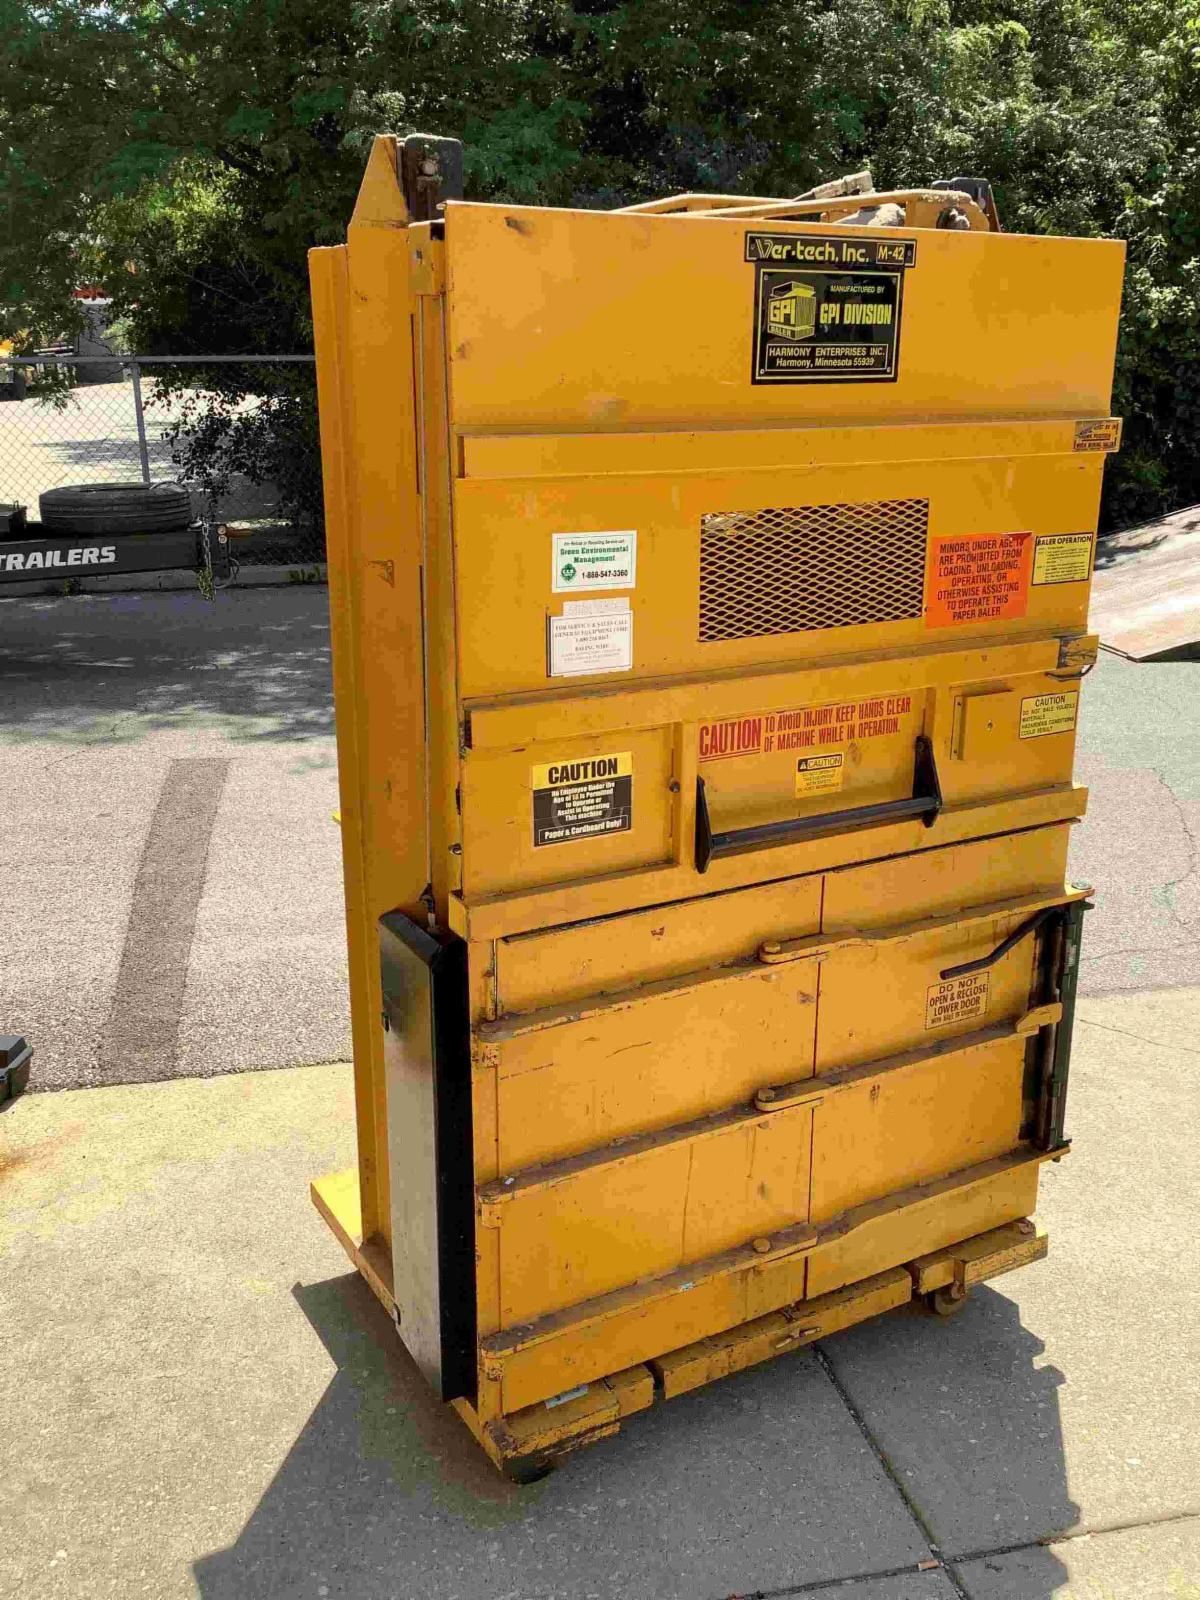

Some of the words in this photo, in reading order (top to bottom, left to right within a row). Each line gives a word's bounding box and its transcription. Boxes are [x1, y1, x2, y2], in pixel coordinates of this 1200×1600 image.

[843, 243, 869, 262] Inc.
[878, 246, 904, 260] M-42
[830, 285, 875, 293] MANUFACTURED
[877, 286, 885, 294] BY
[770, 299, 796, 324] GPI
[820, 303, 839, 324] GPI
[844, 304, 892, 325] DIVISION
[769, 347, 811, 356] HARMONY
[816, 347, 866, 356] ENTERPRISES
[870, 348, 885, 356] INC.
[776, 358, 813, 368] Harmony,
[815, 357, 852, 367] Minnesota
[854, 357, 874, 366] 55939
[940, 542, 969, 553] MINORS
[972, 540, 996, 551] UNDER
[999, 539, 1012, 548] AGE
[1057, 536, 1091, 545] OPERATION
[581, 546, 628, 554] Environmental
[939, 555, 954, 565] ARE
[956, 551, 999, 563] PROHIBITED
[1002, 549, 1022, 560] FROM
[574, 555, 615, 563] Management
[939, 565, 972, 577] LOADING,
[976, 560, 1020, 573] UNLOADING,
[951, 574, 995, 587] OPERATING,
[997, 572, 1008, 583] OR
[938, 587, 980, 600] OTHERWISE
[982, 582, 1019, 596] ASSISTING
[947, 601, 957, 611] TO
[958, 596, 990, 609] OPERATE
[993, 594, 1008, 604] THIS
[952, 610, 977, 621] PAPER
[978, 607, 1001, 617] BALER
[1035, 695, 1065, 707] CAUTION
[700, 718, 761, 755] CAUTION
[765, 716, 775, 733] TO
[777, 712, 801, 731] AVOID
[804, 708, 833, 727] INJURY
[836, 705, 855, 722] KEEP
[859, 701, 883, 719] HANDS
[887, 697, 911, 715] CLEAR
[1022, 720, 1047, 728] HAZARDOUS
[1049, 717, 1074, 725] CONDITIONS
[764, 736, 774, 752] OF
[777, 730, 815, 750] MACHINE
[819, 726, 843, 744] WHILE
[847, 723, 855, 740] IN
[859, 718, 900, 738] OPERATION.
[808, 757, 840, 768] CAUTION
[548, 758, 617, 784] CAUTION
[560, 787, 588, 796] Employee
[588, 783, 605, 791] Under
[586, 788, 613, 798] Permitted
[558, 808, 574, 816] Assist
[582, 803, 610, 812] Operating
[573, 799, 594, 807] Operate
[545, 829, 564, 839] Paper
[571, 822, 605, 835] Cardboard
[939, 984, 954, 994] DO
[958, 977, 978, 988] NOT
[930, 994, 948, 1007] OPEN
[950, 993, 956, 1001] &
[956, 984, 986, 999] RECLOSE
[934, 1001, 959, 1016] LOWER
[960, 996, 981, 1009] DOOR
